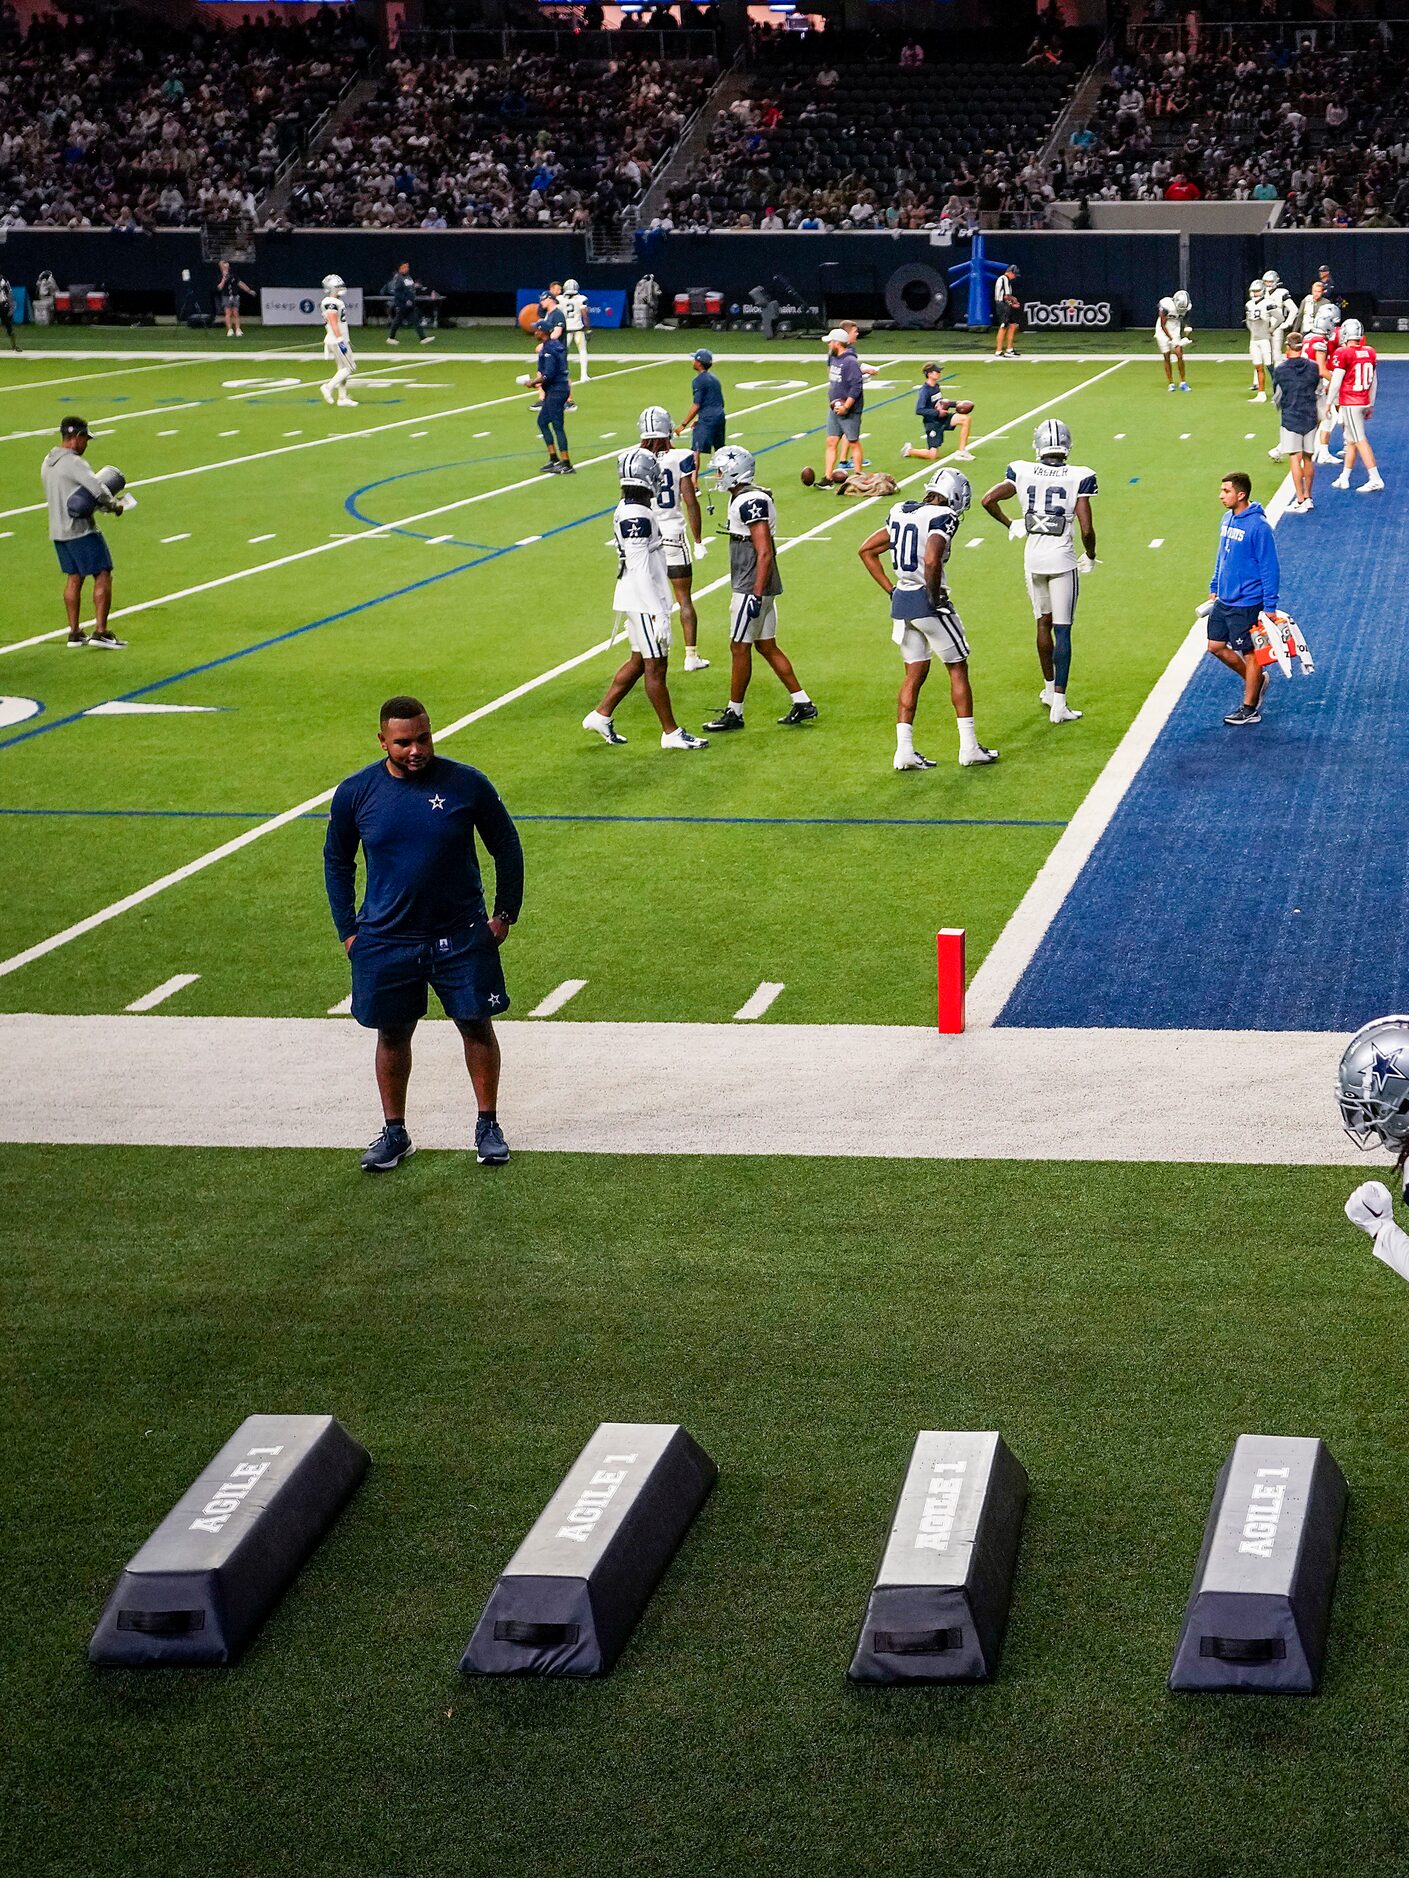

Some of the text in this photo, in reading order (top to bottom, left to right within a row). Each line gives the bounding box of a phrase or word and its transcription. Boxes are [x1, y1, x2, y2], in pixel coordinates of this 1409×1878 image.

[1353, 362, 1374, 391] 10
[188, 1445, 285, 1533] AGILE 1
[555, 1453, 639, 1543] AGILE 1
[914, 1460, 968, 1551] AGILE 1
[1238, 1467, 1290, 1558] AGILE 1
